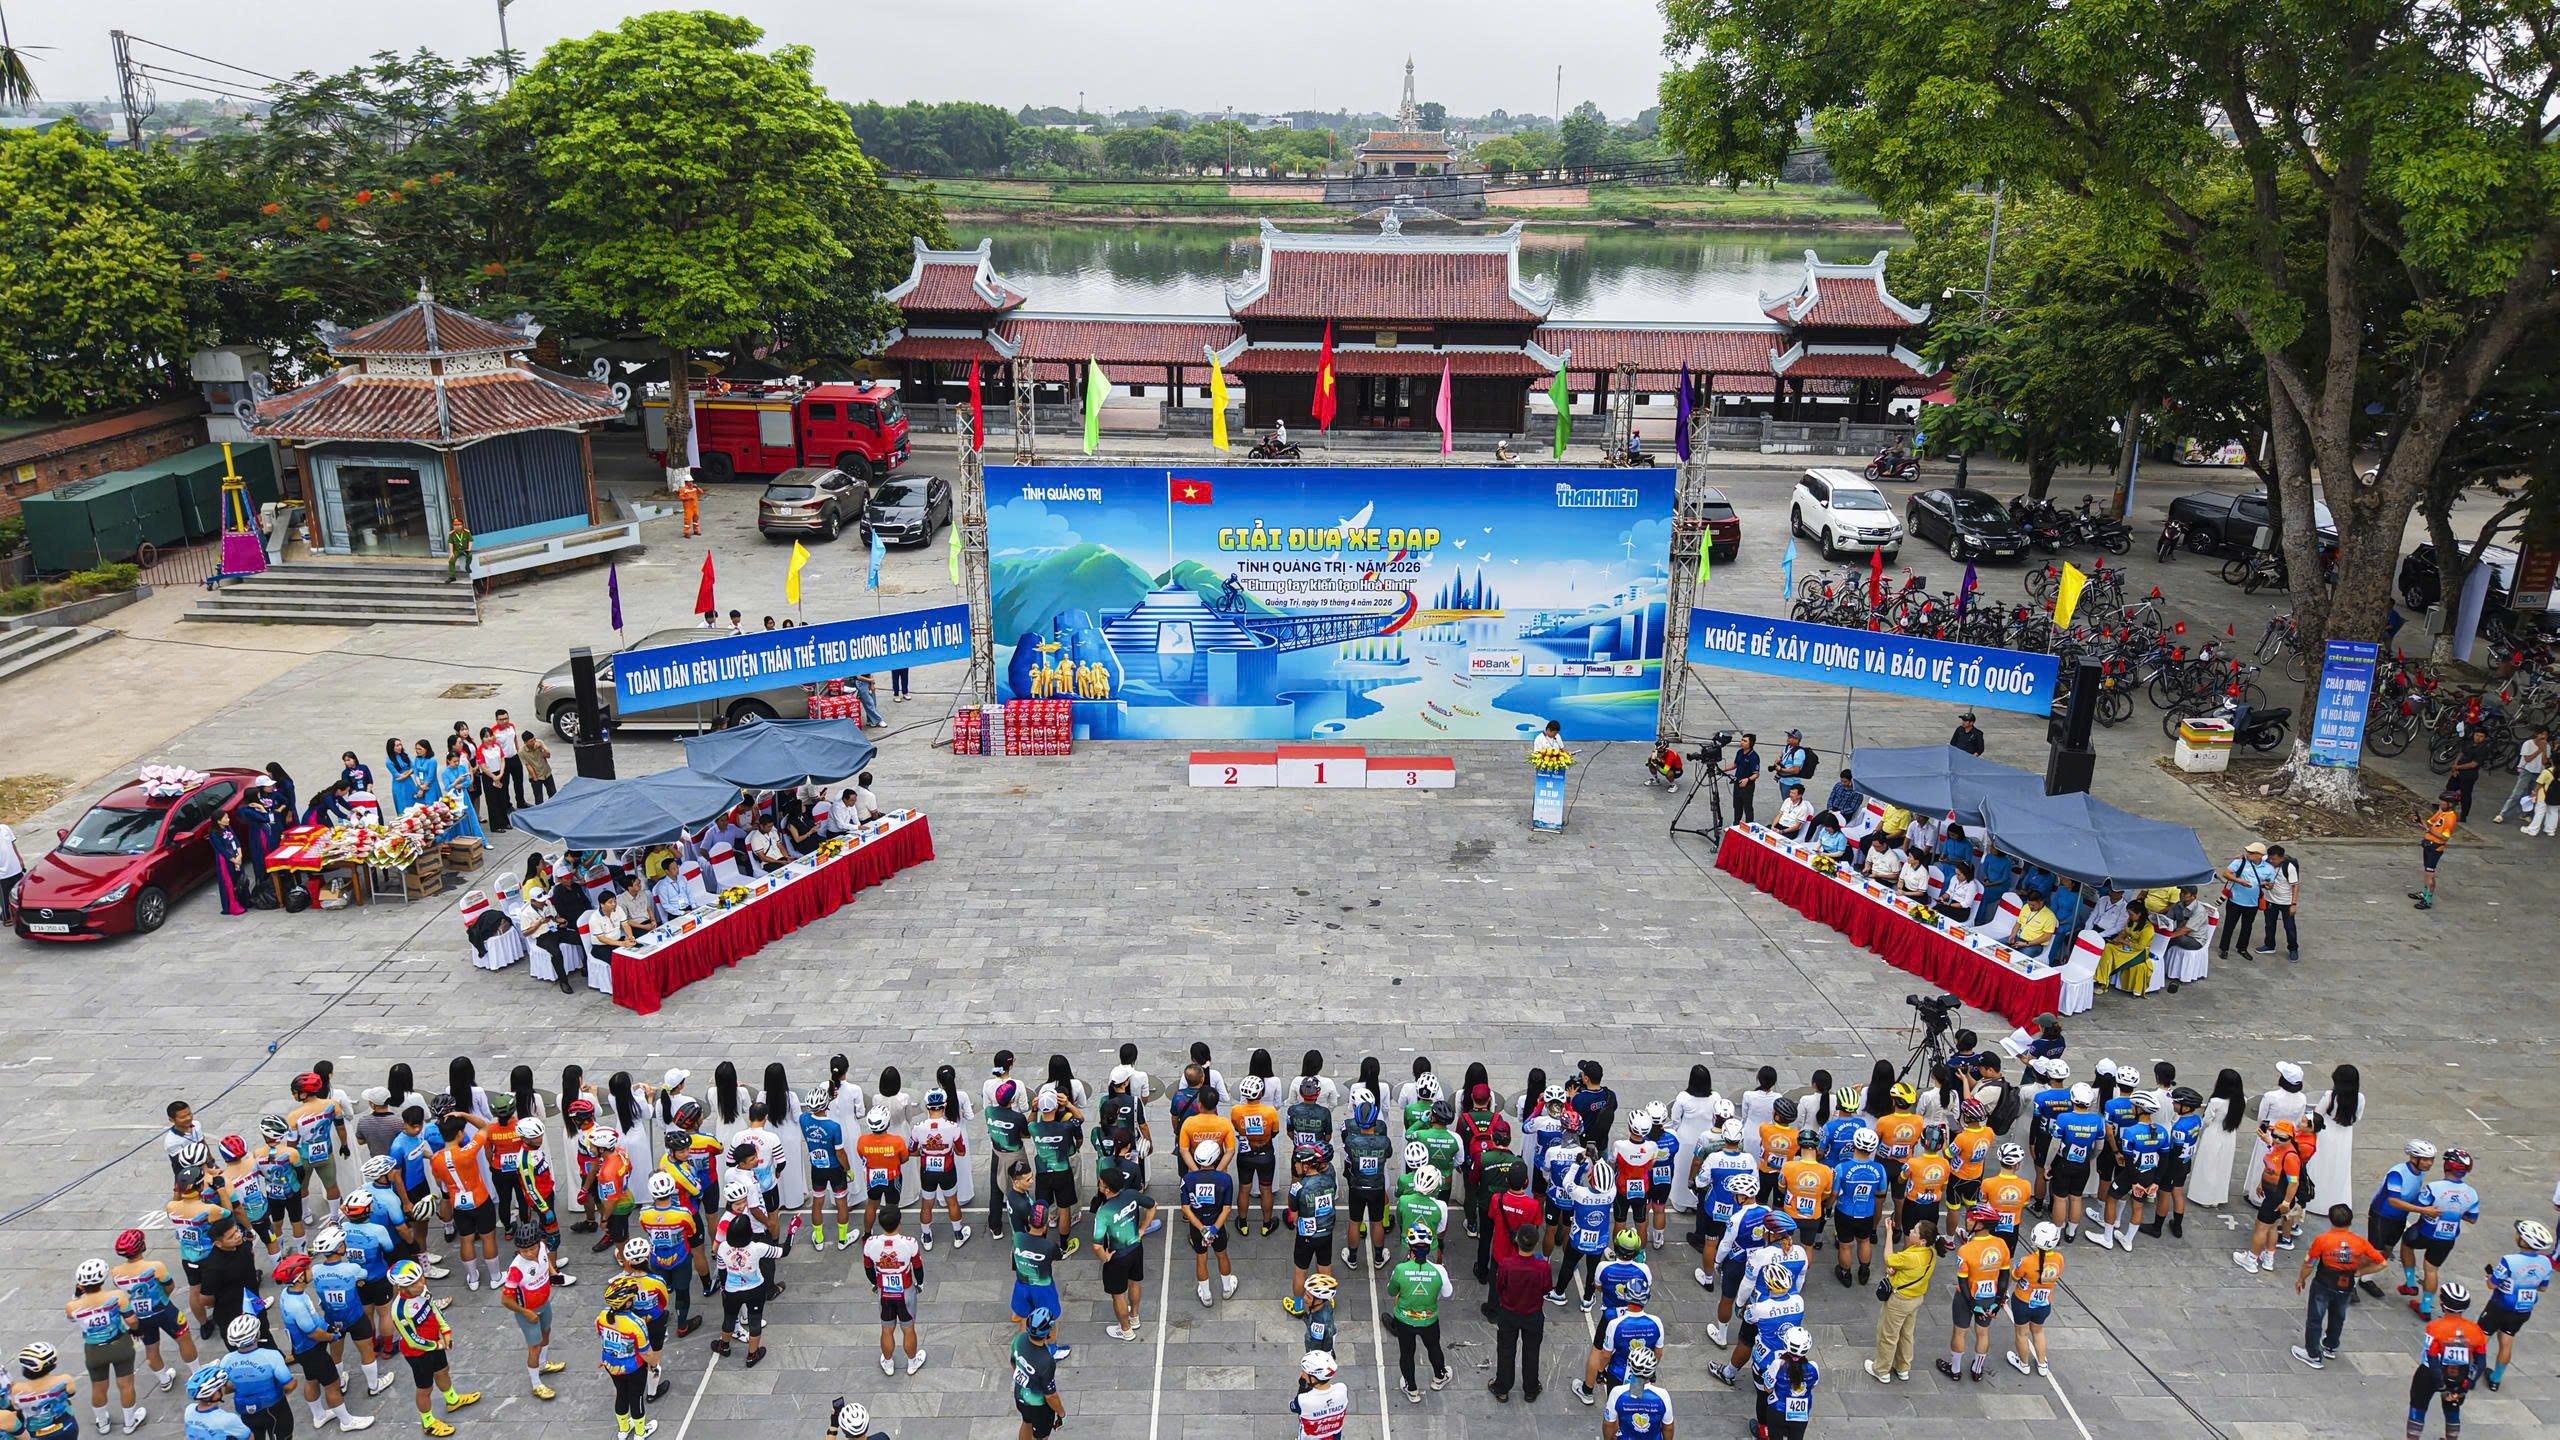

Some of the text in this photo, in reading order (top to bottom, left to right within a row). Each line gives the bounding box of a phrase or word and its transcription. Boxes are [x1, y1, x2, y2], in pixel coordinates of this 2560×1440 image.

[1022, 484, 1102, 504] TỈNH QUẢNG TRỊ
[1557, 488, 1638, 507] THANH NIÊN
[1218, 519, 1441, 558] GIẢI ĐUA XE ĐẠP
[1238, 559, 1270, 572] TỈNH
[1272, 559, 1322, 574] QUẢNG
[1326, 562, 1346, 575] TRỊ
[1356, 560, 1387, 572] NĂM
[1389, 562, 1421, 573] 2026
[1287, 580, 1307, 593] tay
[1311, 578, 1336, 592] kiến
[1338, 580, 1358, 594] tạo
[1265, 598, 1292, 609] Quảng
[1302, 600, 1318, 610] ngày
[1320, 598, 1328, 607] 19
[1329, 598, 1350, 610] tháng
[1352, 598, 1356, 607] 4
[1357, 598, 1372, 607] năm
[1374, 598, 1393, 607] 2026
[626, 621, 963, 696] TOÀN DÂN RÈN LUYỆN THÂN THỂ THEO GƯƠNG BÁC HỒ VĨ ĐẠI
[1472, 659, 1510, 668] HDBank
[1705, 623, 2034, 696] KHỎE ĐỂ XÂY DỰNG VÀ BẢO VỆ TỔ QUỐC
[2325, 676, 2366, 692] CHÀO MỪNG
[2342, 692, 2354, 709] HỘI
[2321, 706, 2328, 720] VÌ
[2344, 706, 2361, 722] BÌNH
[2320, 722, 2356, 738] NĂM 2026
[1224, 767, 1238, 784] 2
[1313, 762, 1328, 784] 1
[1406, 772, 1418, 786] 3
[1248, 1116, 1261, 1126] 142
[1300, 1134, 1314, 1142] 122
[311, 1144, 327, 1156] 294
[812, 1150, 826, 1160] 304
[2073, 1147, 2085, 1157] 40
[929, 1158, 944, 1168] 163
[1362, 1158, 1376, 1169] 230
[1770, 1156, 1784, 1167] 211
[2144, 1154, 2154, 1165] 38
[872, 1170, 886, 1180] 206
[1656, 1168, 1670, 1178] 419
[244, 1183, 258, 1196] 295
[1198, 1186, 1213, 1196] 272
[1630, 1182, 1643, 1192] 258
[1857, 1186, 1868, 1194] 20
[460, 1195, 467, 1205] 6
[1800, 1198, 1814, 1209] 210
[1717, 1204, 1731, 1214] 307
[182, 1230, 197, 1241] 298
[654, 1230, 670, 1240] 238
[1583, 1232, 1598, 1243] 310
[886, 1276, 900, 1286] 160
[328, 1291, 344, 1303] 116
[2033, 1290, 2048, 1302] 401
[134, 1302, 150, 1312] 155
[89, 1314, 108, 1327] 433
[606, 1330, 620, 1343] 417
[2448, 1349, 2465, 1362] 311
[240, 1360, 257, 1368] ĐÔNG
[1789, 1400, 1806, 1412] 420
